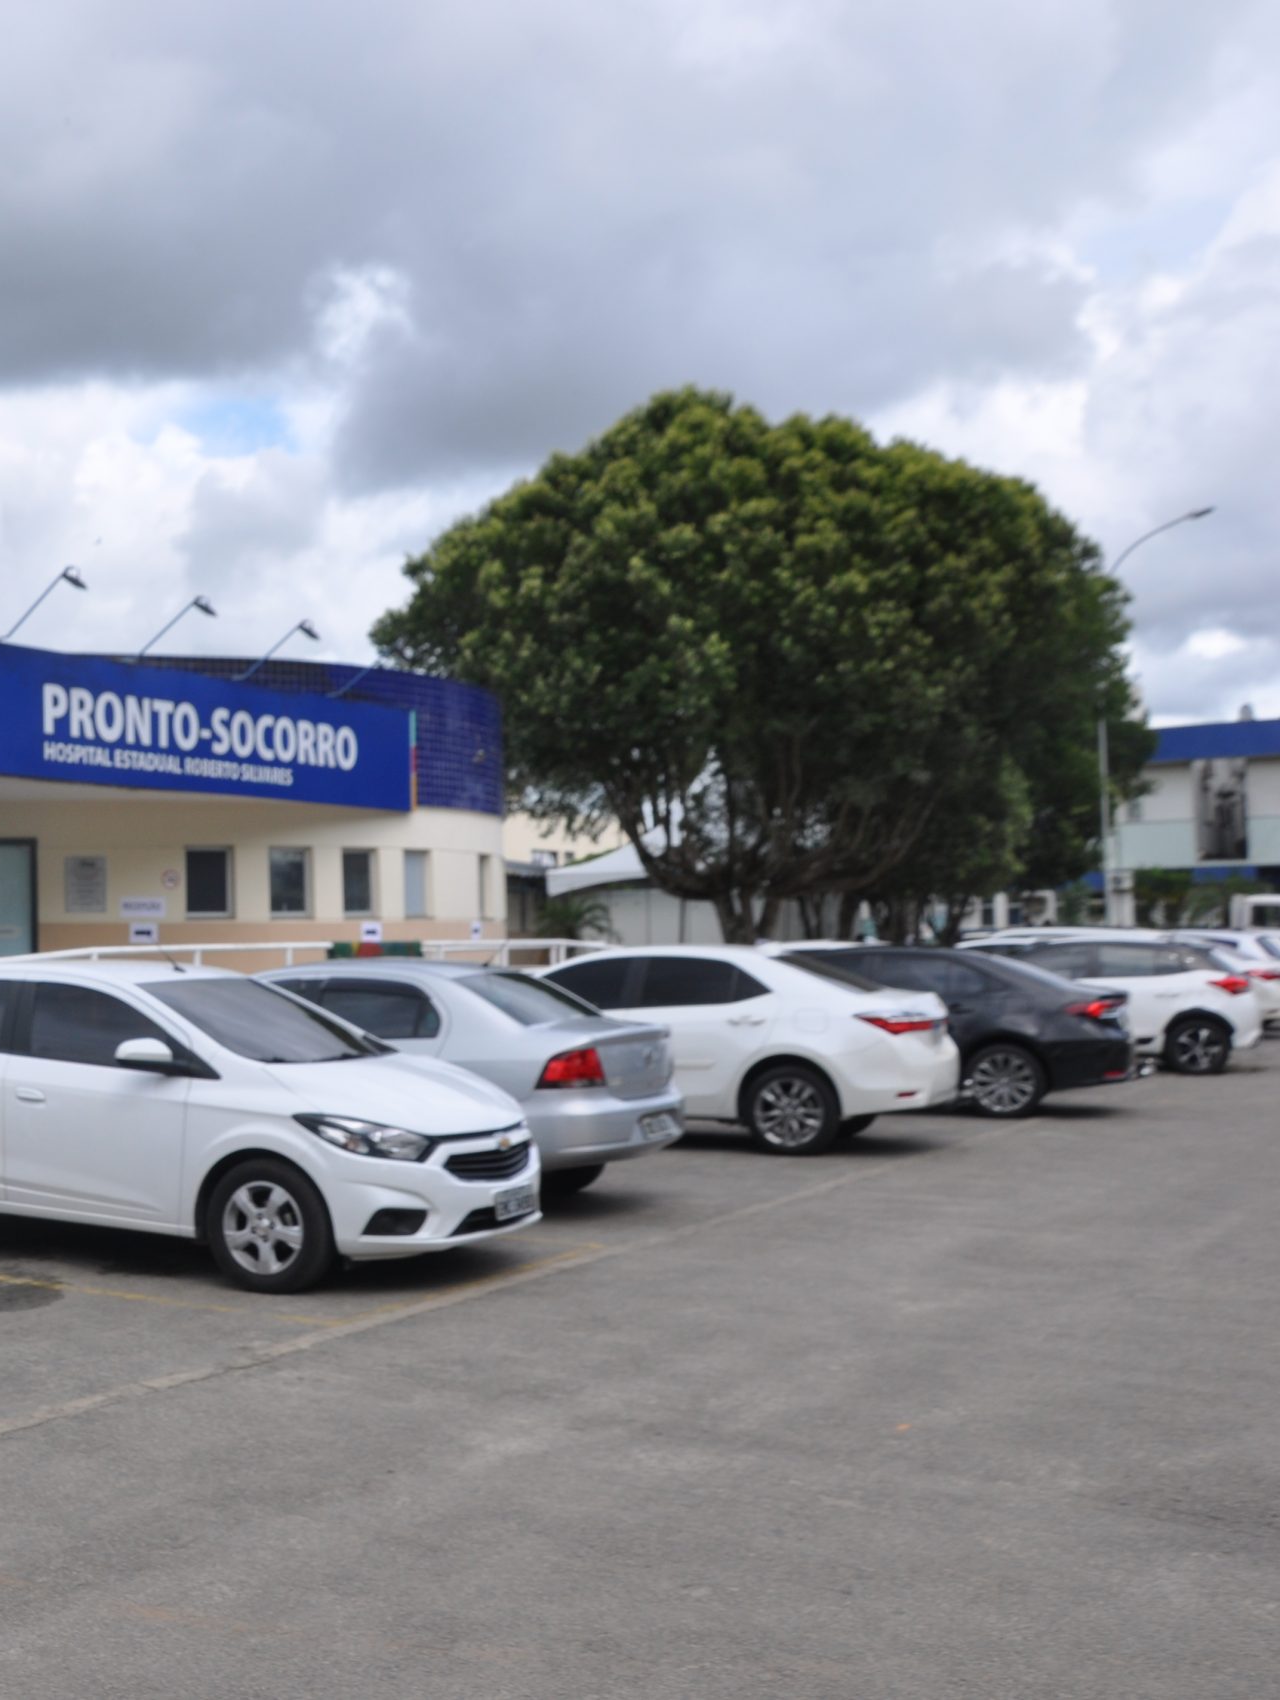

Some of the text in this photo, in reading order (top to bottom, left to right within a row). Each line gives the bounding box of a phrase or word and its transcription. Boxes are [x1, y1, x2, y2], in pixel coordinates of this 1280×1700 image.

[42, 683, 358, 771] PRONTO-SOCORRO
[43, 741, 112, 767] HOSPITAL
[114, 749, 182, 774] ESTADUAL
